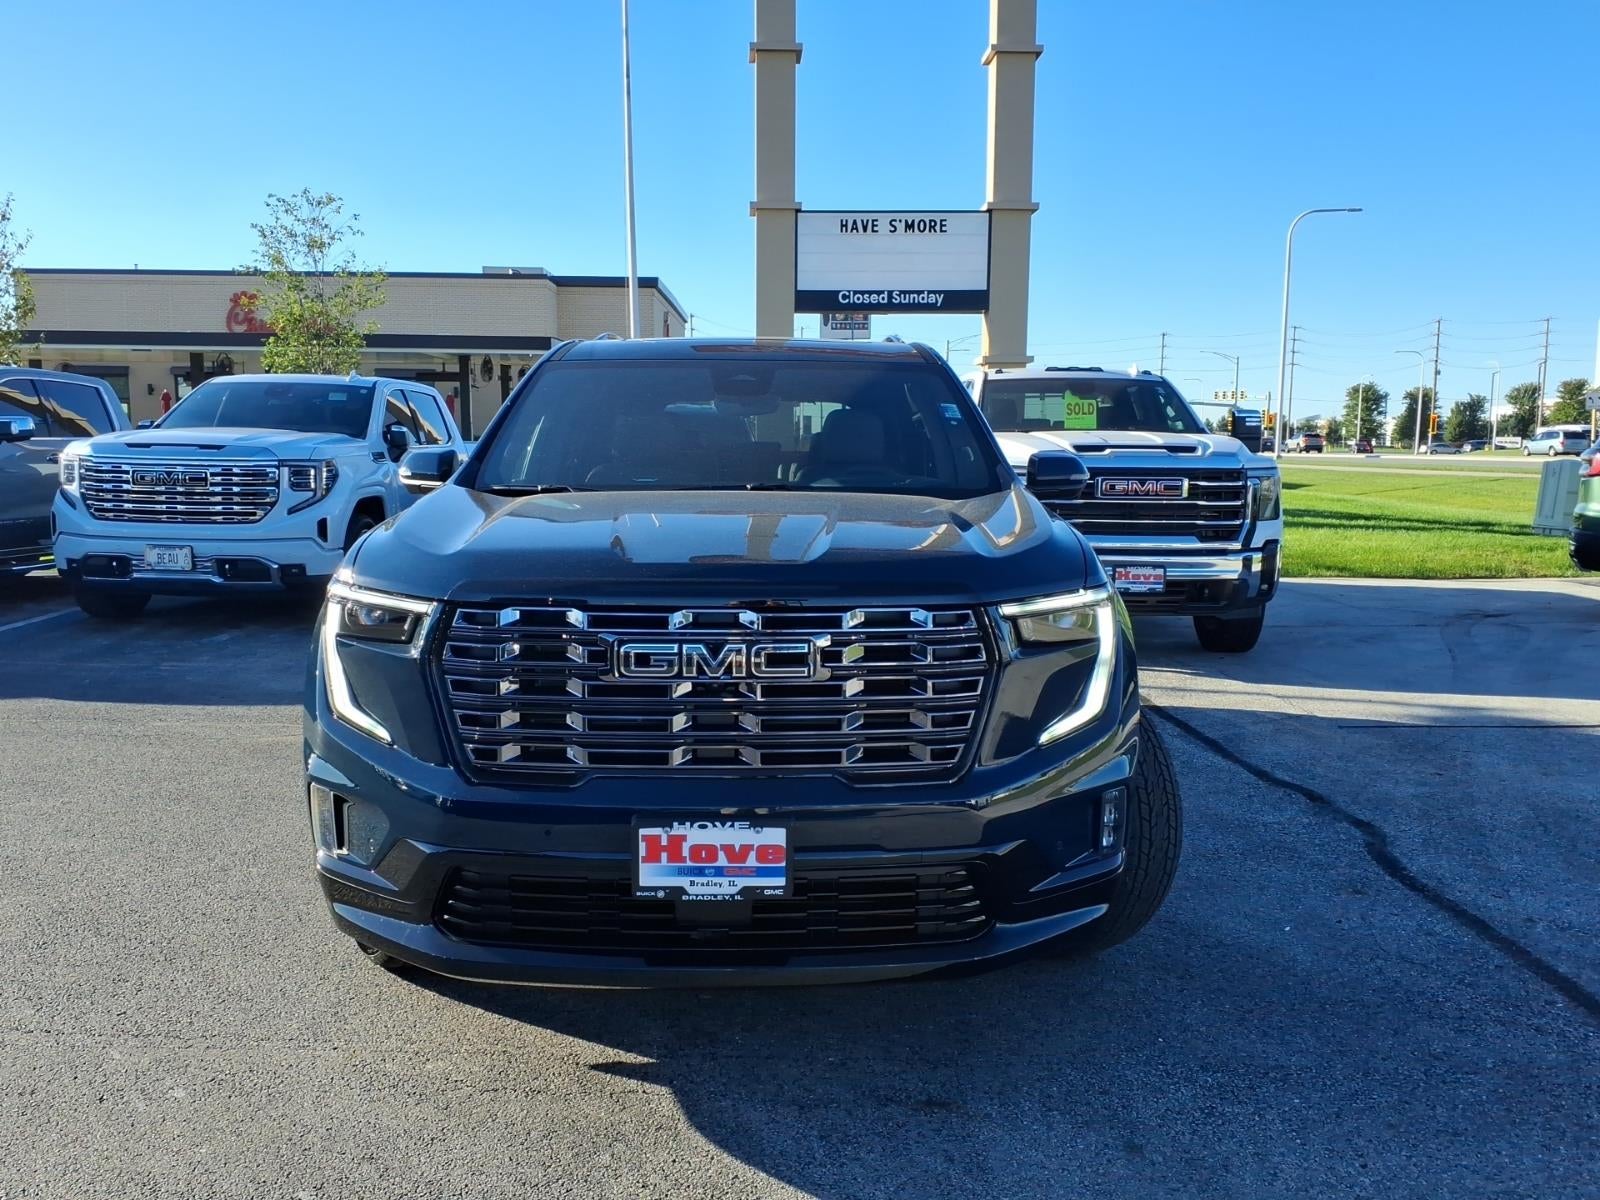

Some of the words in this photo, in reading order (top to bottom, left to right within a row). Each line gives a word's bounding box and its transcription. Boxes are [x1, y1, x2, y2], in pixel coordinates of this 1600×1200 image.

[840, 219, 879, 233] HAVE
[889, 218, 948, 233] S'MORE
[838, 291, 888, 304] Closed
[892, 291, 944, 307] Sunday
[1066, 402, 1095, 416] SOLD
[134, 471, 206, 486] GMC
[1102, 480, 1182, 495] GMC
[157, 552, 179, 565] BEAU
[620, 643, 809, 677] GMC
[672, 821, 750, 831] HOVE
[641, 834, 785, 865] Hove
[689, 879, 725, 888] Bradley,
[728, 879, 738, 887] IL
